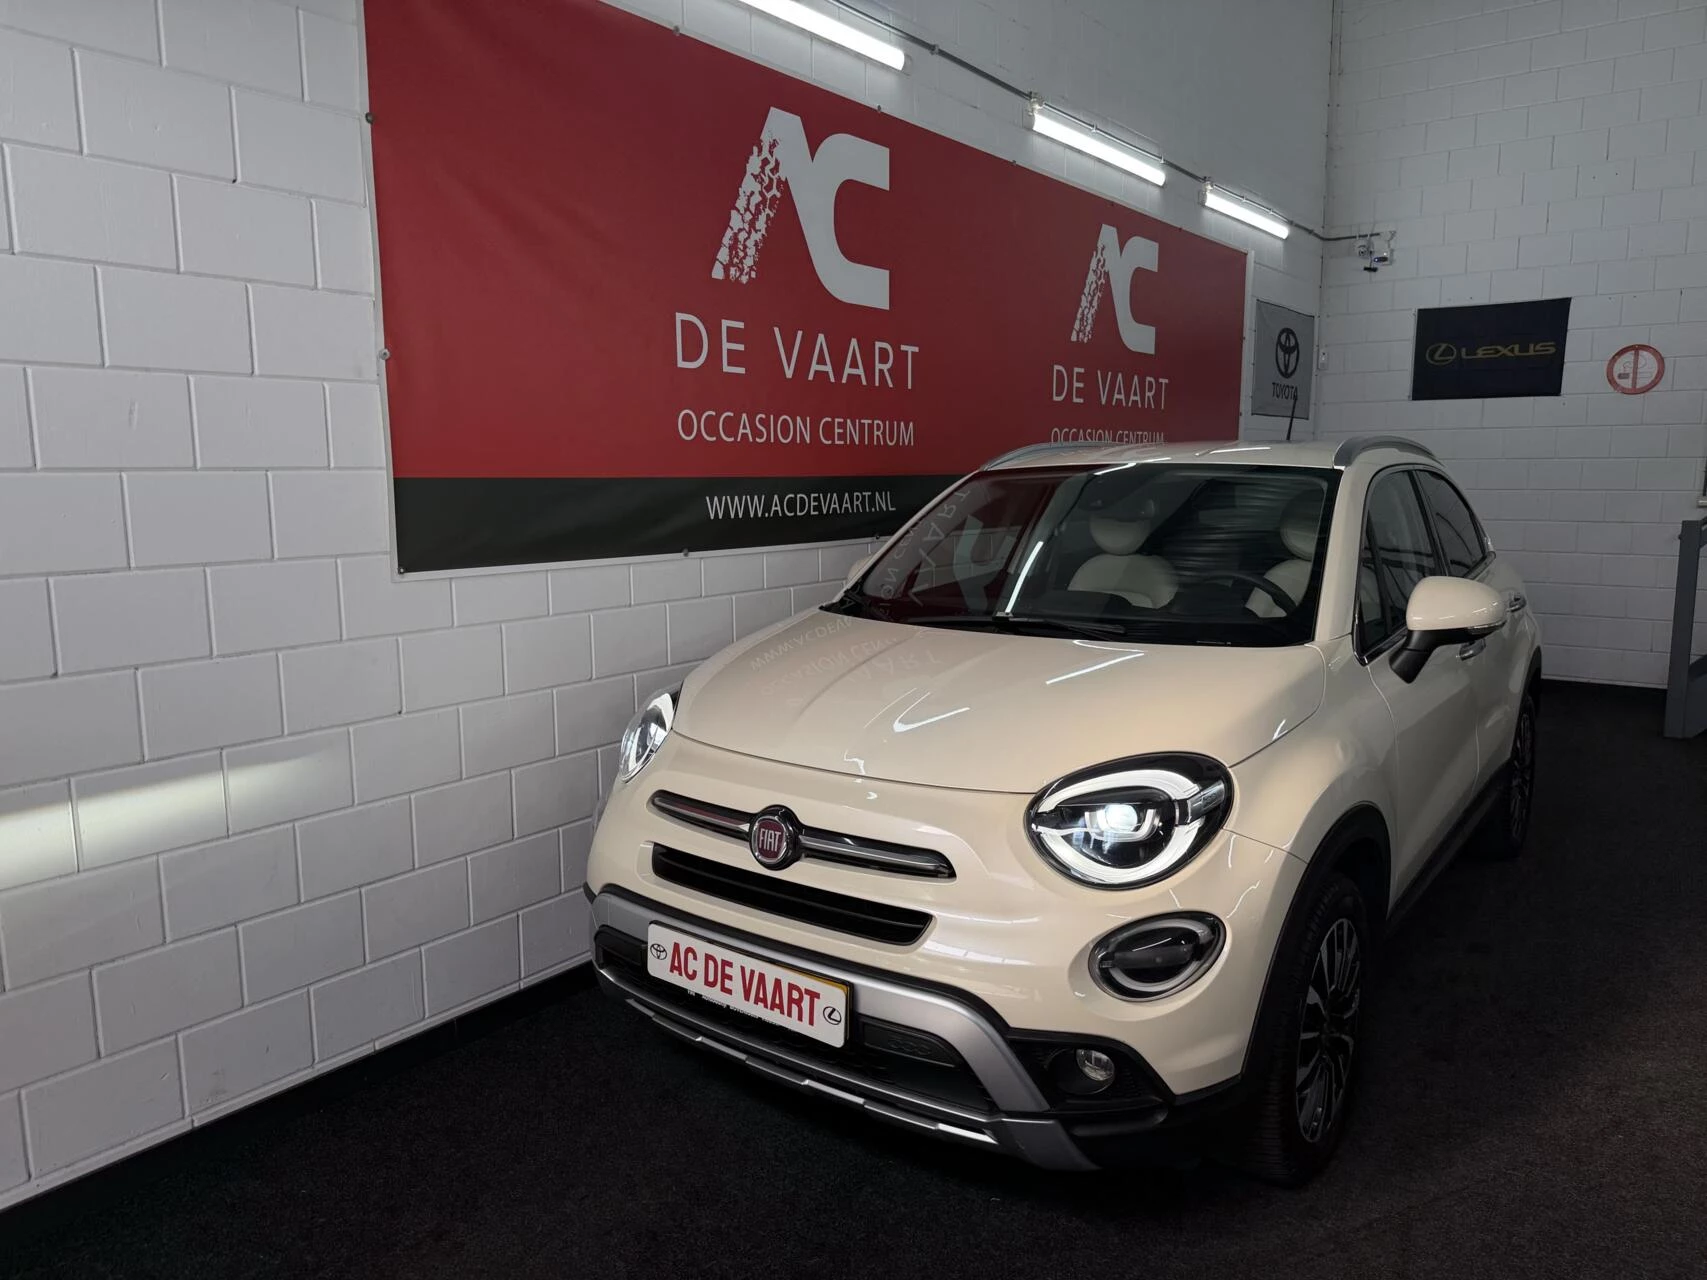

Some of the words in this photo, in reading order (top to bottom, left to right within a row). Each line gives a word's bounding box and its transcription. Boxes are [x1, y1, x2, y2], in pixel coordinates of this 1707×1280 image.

[711, 106, 890, 311] AC
[675, 312, 746, 375] DE
[773, 326, 919, 390] VAART
[1461, 341, 1557, 360] LEXUS
[1052, 364, 1085, 404] DE
[1097, 369, 1169, 410] VAART
[1272, 382, 1298, 401] TOYOTA
[677, 408, 812, 445] OCCASION
[818, 416, 915, 447] CENTRUM
[705, 491, 897, 520] WWW.ACDEVAART.NL
[758, 828, 782, 852] FIAT
[669, 941, 698, 981] AC
[703, 952, 734, 996] DE
[739, 965, 821, 1027] VAART
